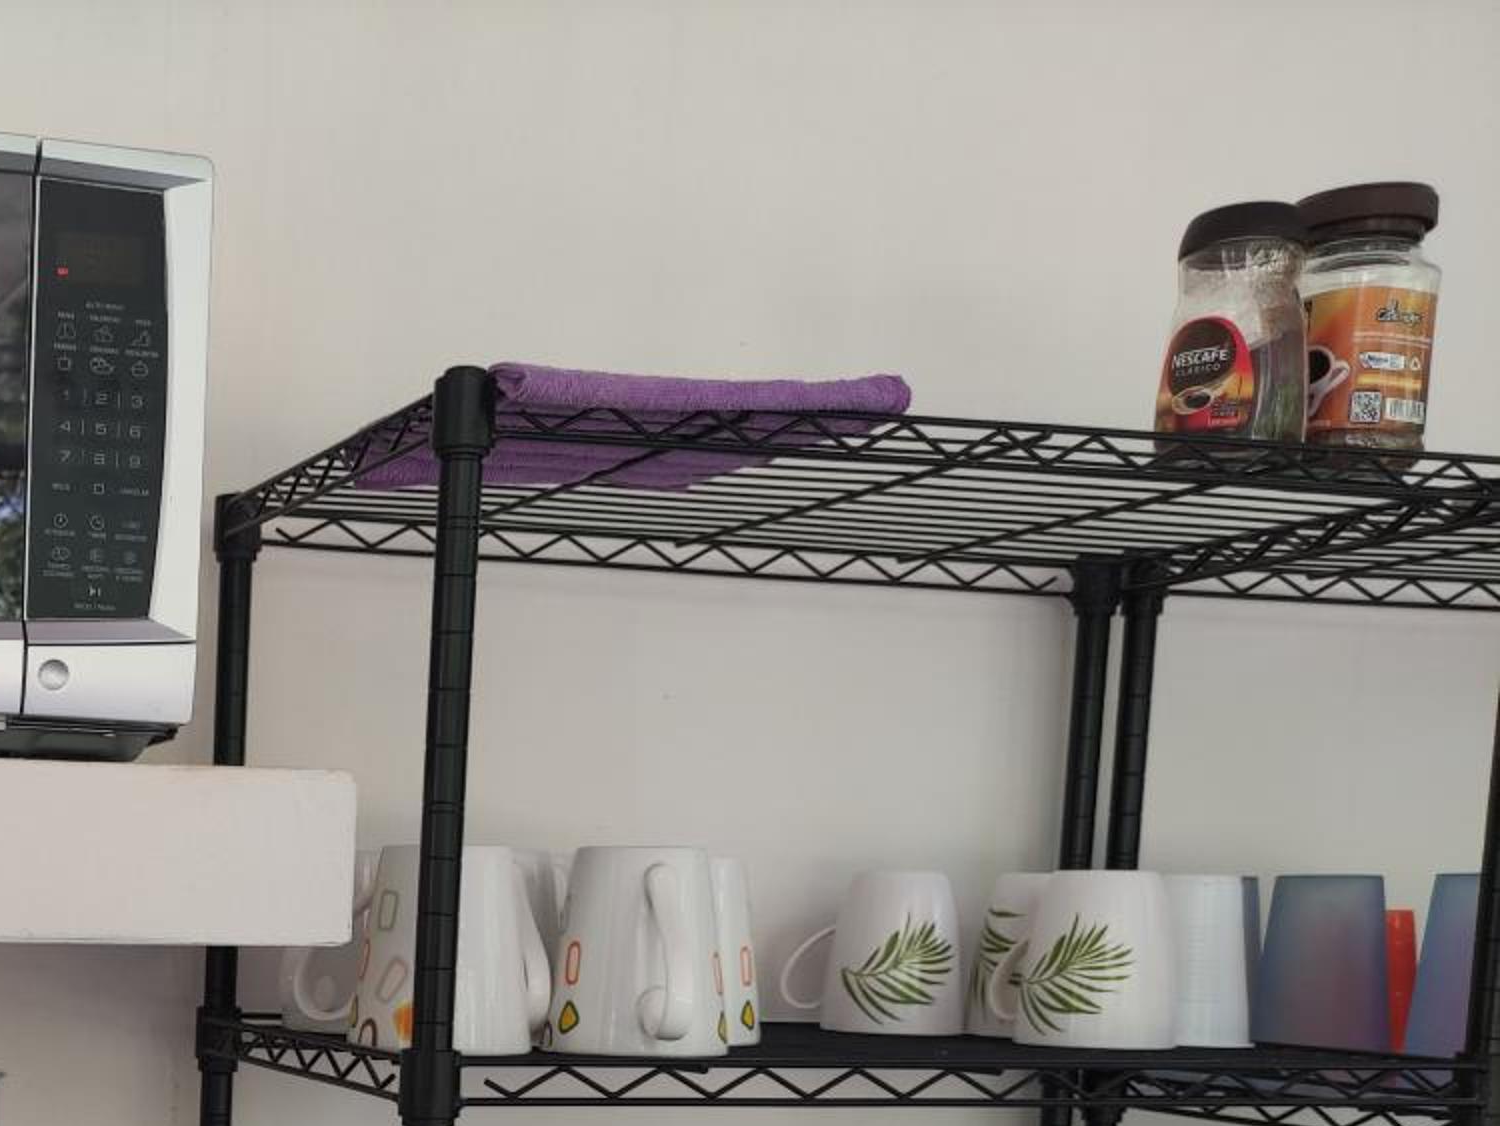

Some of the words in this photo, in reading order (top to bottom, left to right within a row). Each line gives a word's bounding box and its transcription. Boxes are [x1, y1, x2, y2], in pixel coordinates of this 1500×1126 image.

[95, 392, 108, 405] 2
[131, 395, 143, 409] 3
[59, 419, 71, 433] 4
[95, 422, 107, 436] 5
[129, 425, 141, 439] 6
[58, 450, 71, 463] 7
[93, 453, 105, 466] 8
[129, 455, 141, 469] 9
